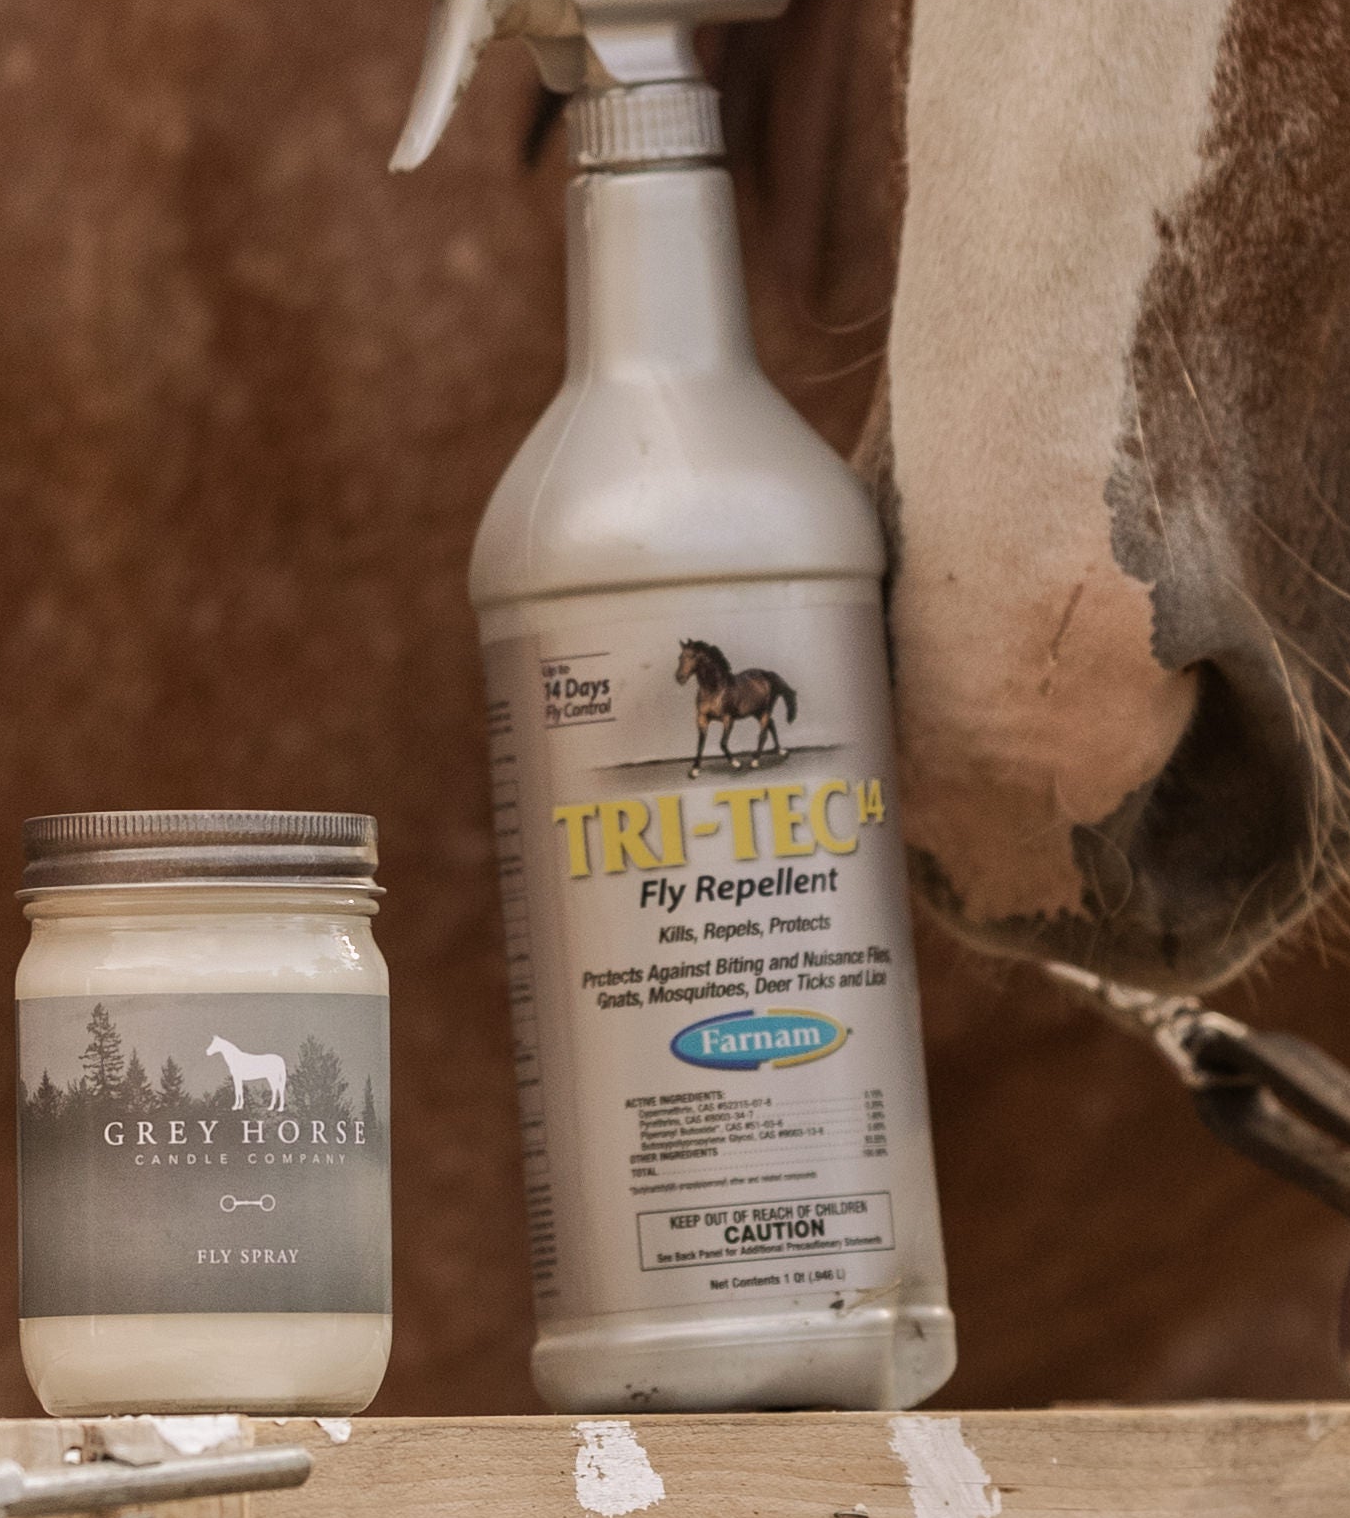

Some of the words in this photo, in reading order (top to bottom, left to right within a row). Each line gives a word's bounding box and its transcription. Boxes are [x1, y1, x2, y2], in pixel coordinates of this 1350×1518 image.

[544, 679, 561, 701] 14
[564, 678, 611, 703] Days
[544, 703, 562, 725] Fly
[563, 697, 612, 719] Control
[640, 878, 686, 913] Fly
[695, 866, 840, 907] Repellent
[658, 924, 699, 945] Kills,
[703, 917, 765, 942] Repels,
[769, 914, 832, 935] Protects
[581, 967, 644, 990] Protects
[647, 960, 712, 985] Against
[715, 956, 765, 977] Biting
[768, 951, 800, 971] and
[803, 949, 865, 969] Nuisance
[597, 989, 644, 1010] Gnats,
[648, 981, 750, 1005] Mosquitoes,
[755, 976, 793, 994] Deer
[798, 973, 837, 992] Ticks
[839, 969, 863, 988] and
[699, 1026, 822, 1055] Farnam
[103, 1120, 219, 1147] GREY
[241, 1119, 367, 1146] HORSE
[134, 1153, 229, 1166] CANDLE
[247, 1152, 347, 1166] COMPANY
[669, 1213, 701, 1230] KEEP
[704, 1211, 728, 1227] OUT
[733, 1209, 749, 1224] OF
[752, 1206, 794, 1222] REACH
[796, 1204, 812, 1219] OF
[814, 1200, 868, 1217] CHILDREN
[723, 1218, 825, 1245] CAUTION
[196, 1248, 233, 1265] FLY
[240, 1248, 300, 1265] SPRAY
[657, 1252, 673, 1264] See
[675, 1250, 696, 1262] Back
[698, 1247, 723, 1260] Panel
[710, 1279, 729, 1291] Net
[732, 1274, 781, 1289] Contents
